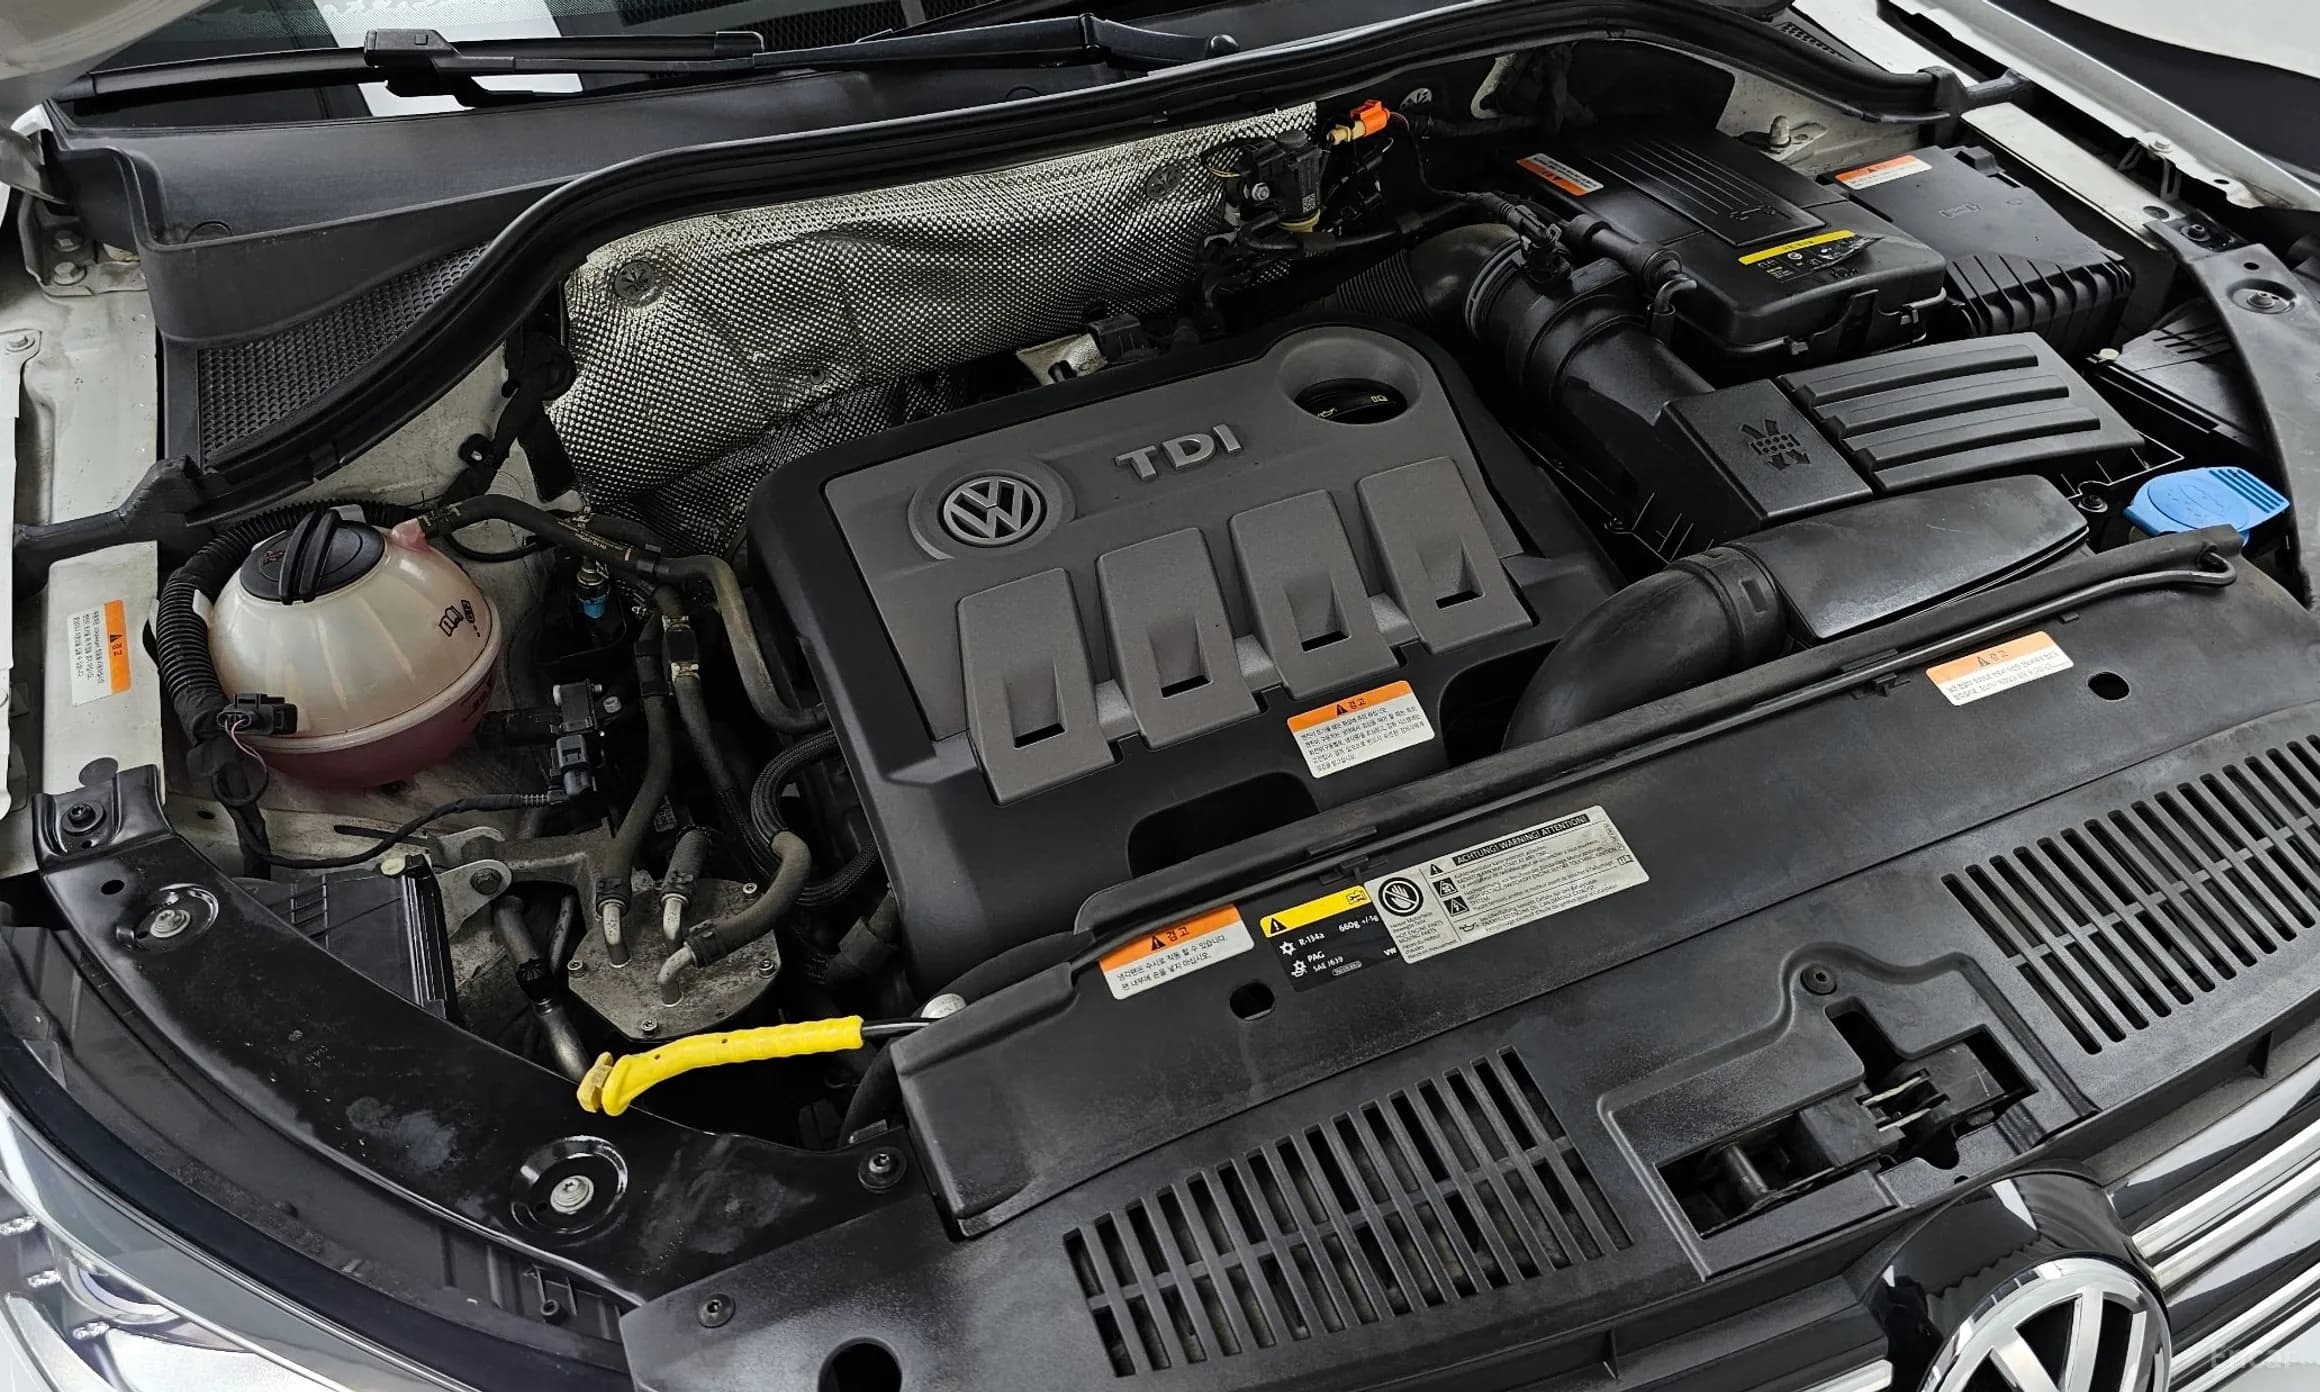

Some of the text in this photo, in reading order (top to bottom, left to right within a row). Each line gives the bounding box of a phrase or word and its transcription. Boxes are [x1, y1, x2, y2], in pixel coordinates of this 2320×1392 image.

[1113, 423, 1242, 480] TDI
[1456, 842, 1500, 865] ACHTUNG!
[1500, 828, 1541, 849] WARNING!
[1542, 814, 1587, 837] ATTENTION!
[1298, 932, 1326, 947] R-134a
[1338, 920, 1361, 932] 660g
[1307, 950, 1326, 963] PAG
